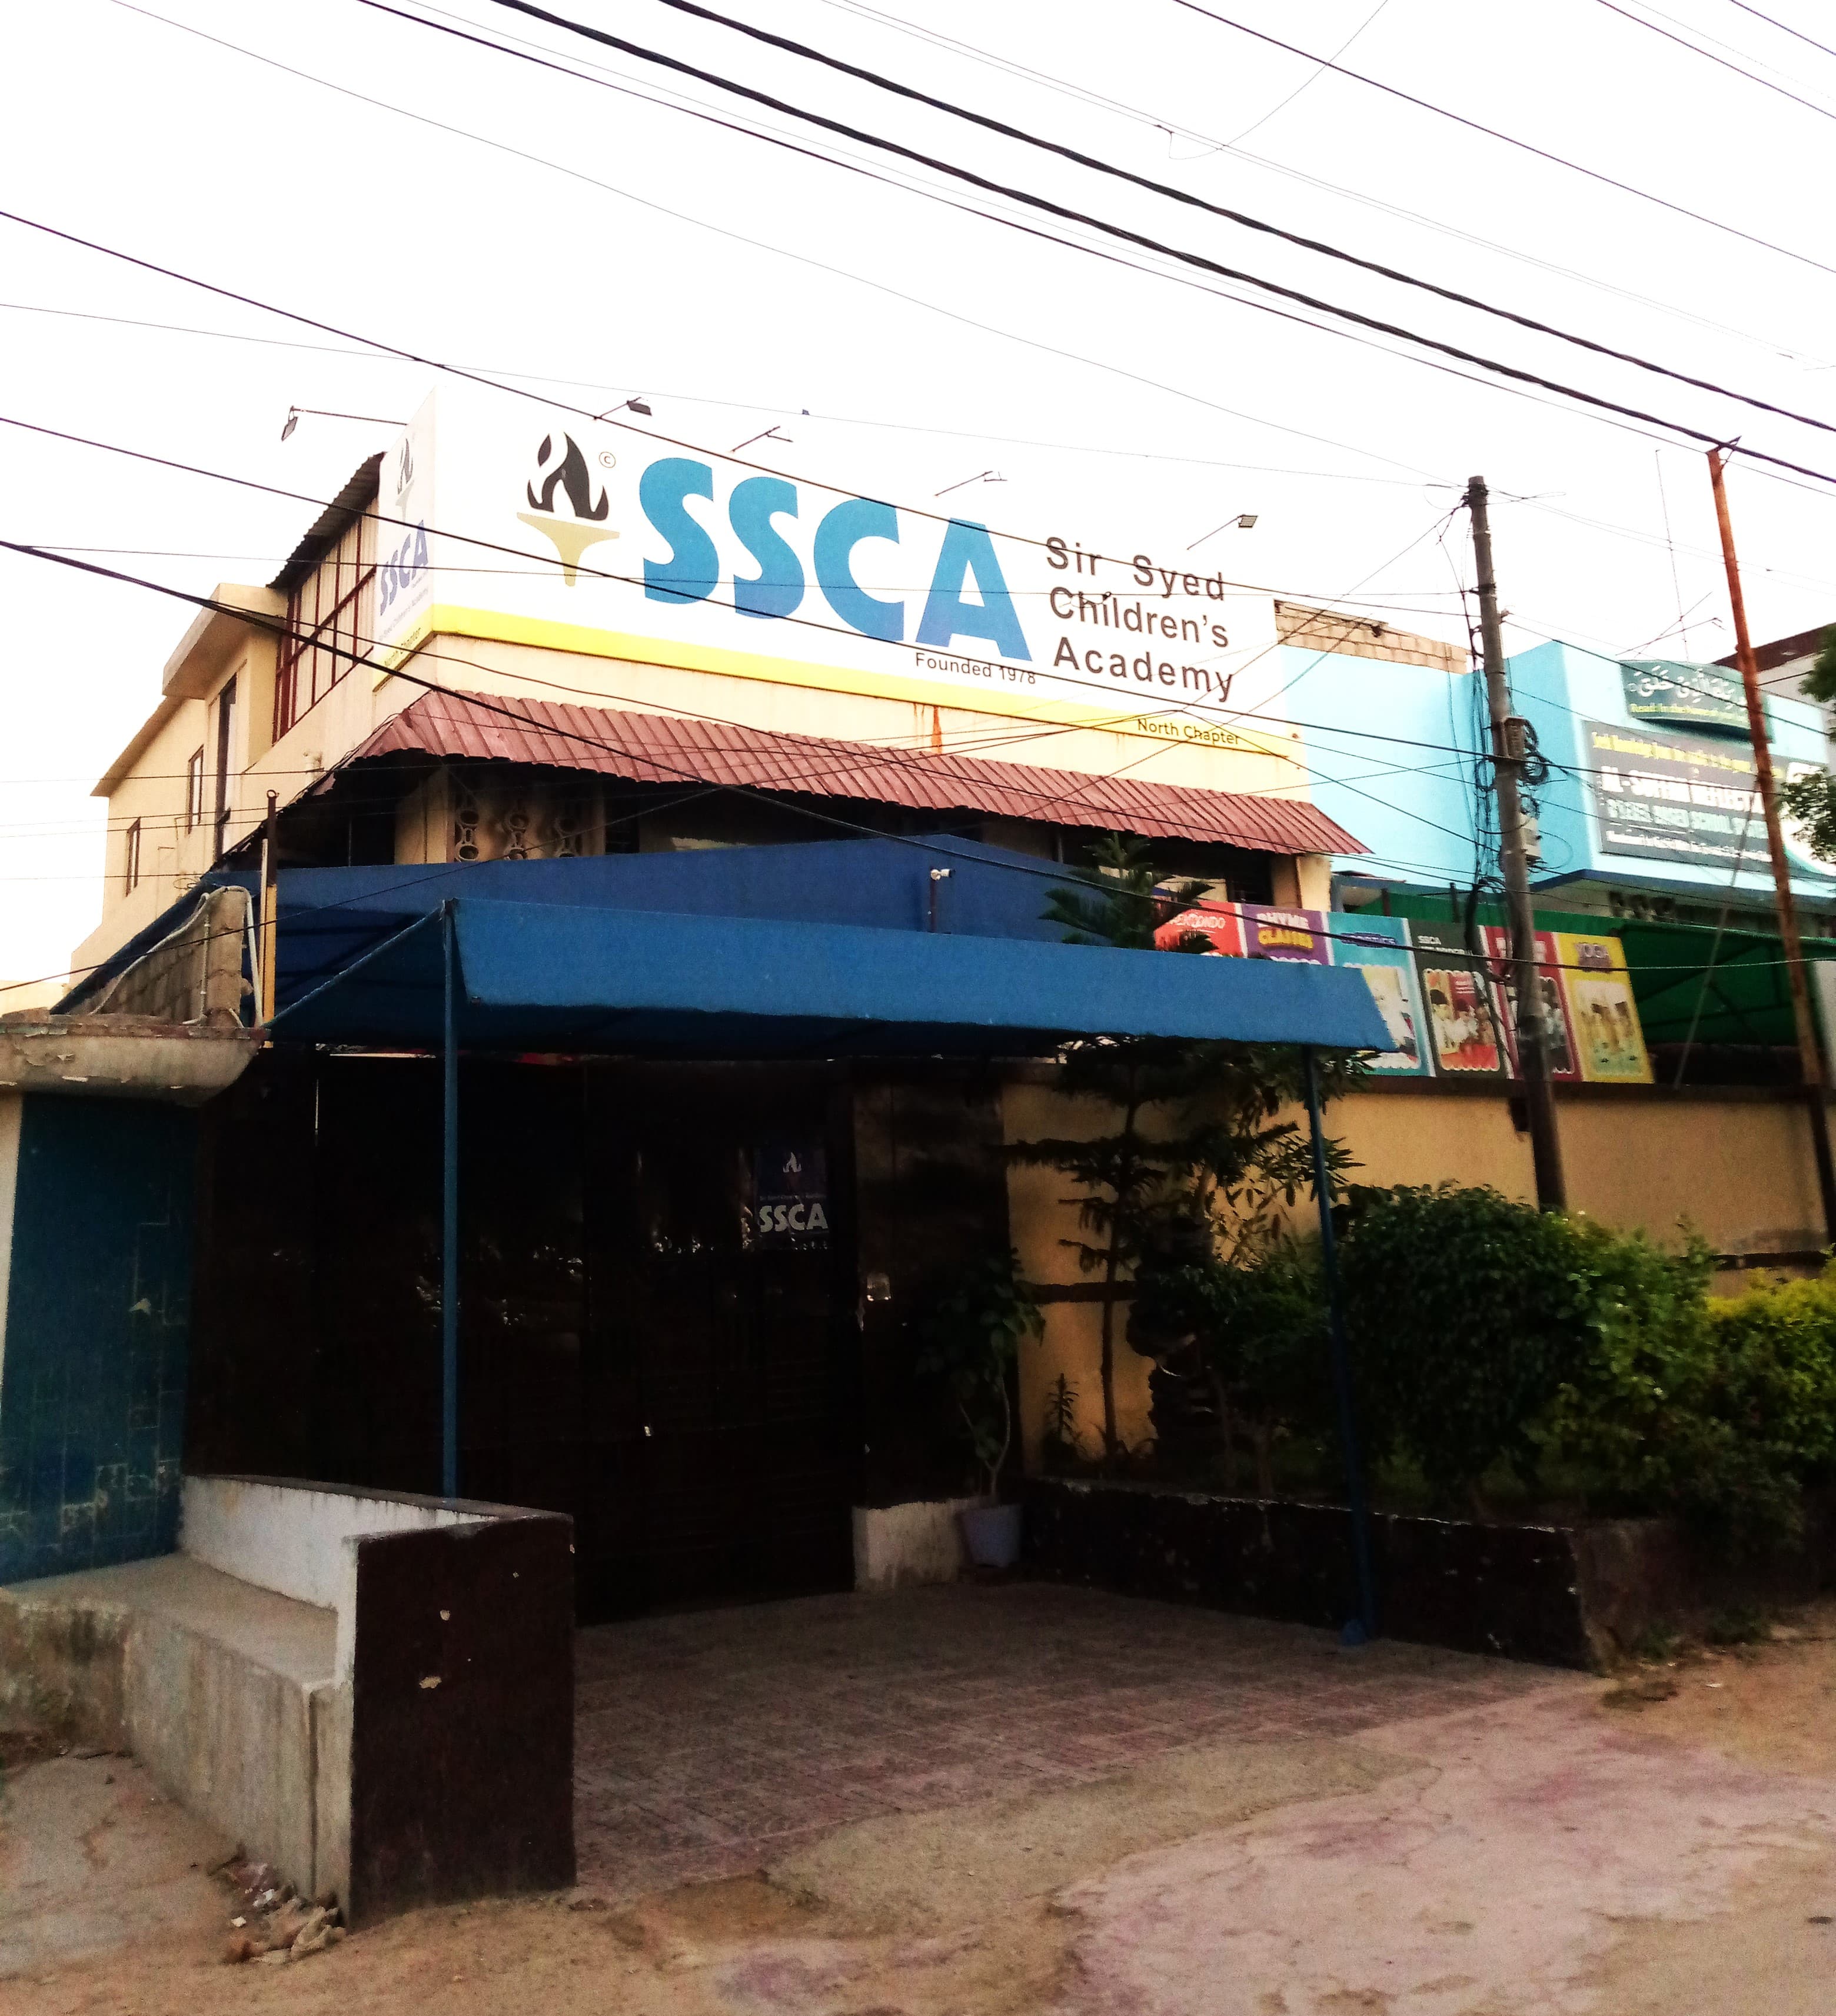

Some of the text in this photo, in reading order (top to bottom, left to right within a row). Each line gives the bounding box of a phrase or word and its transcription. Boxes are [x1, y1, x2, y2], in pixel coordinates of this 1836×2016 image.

[380, 519, 429, 617] SSCA
[639, 457, 1033, 662] SSCA
[1046, 537, 1224, 601] Sir Syed
[1050, 586, 1229, 648] Children's
[916, 652, 1036, 684] Founded 1978
[1053, 636, 1233, 703] Academy
[1137, 718, 1239, 746] North Chapter
[759, 1202, 829, 1233] SSCA
